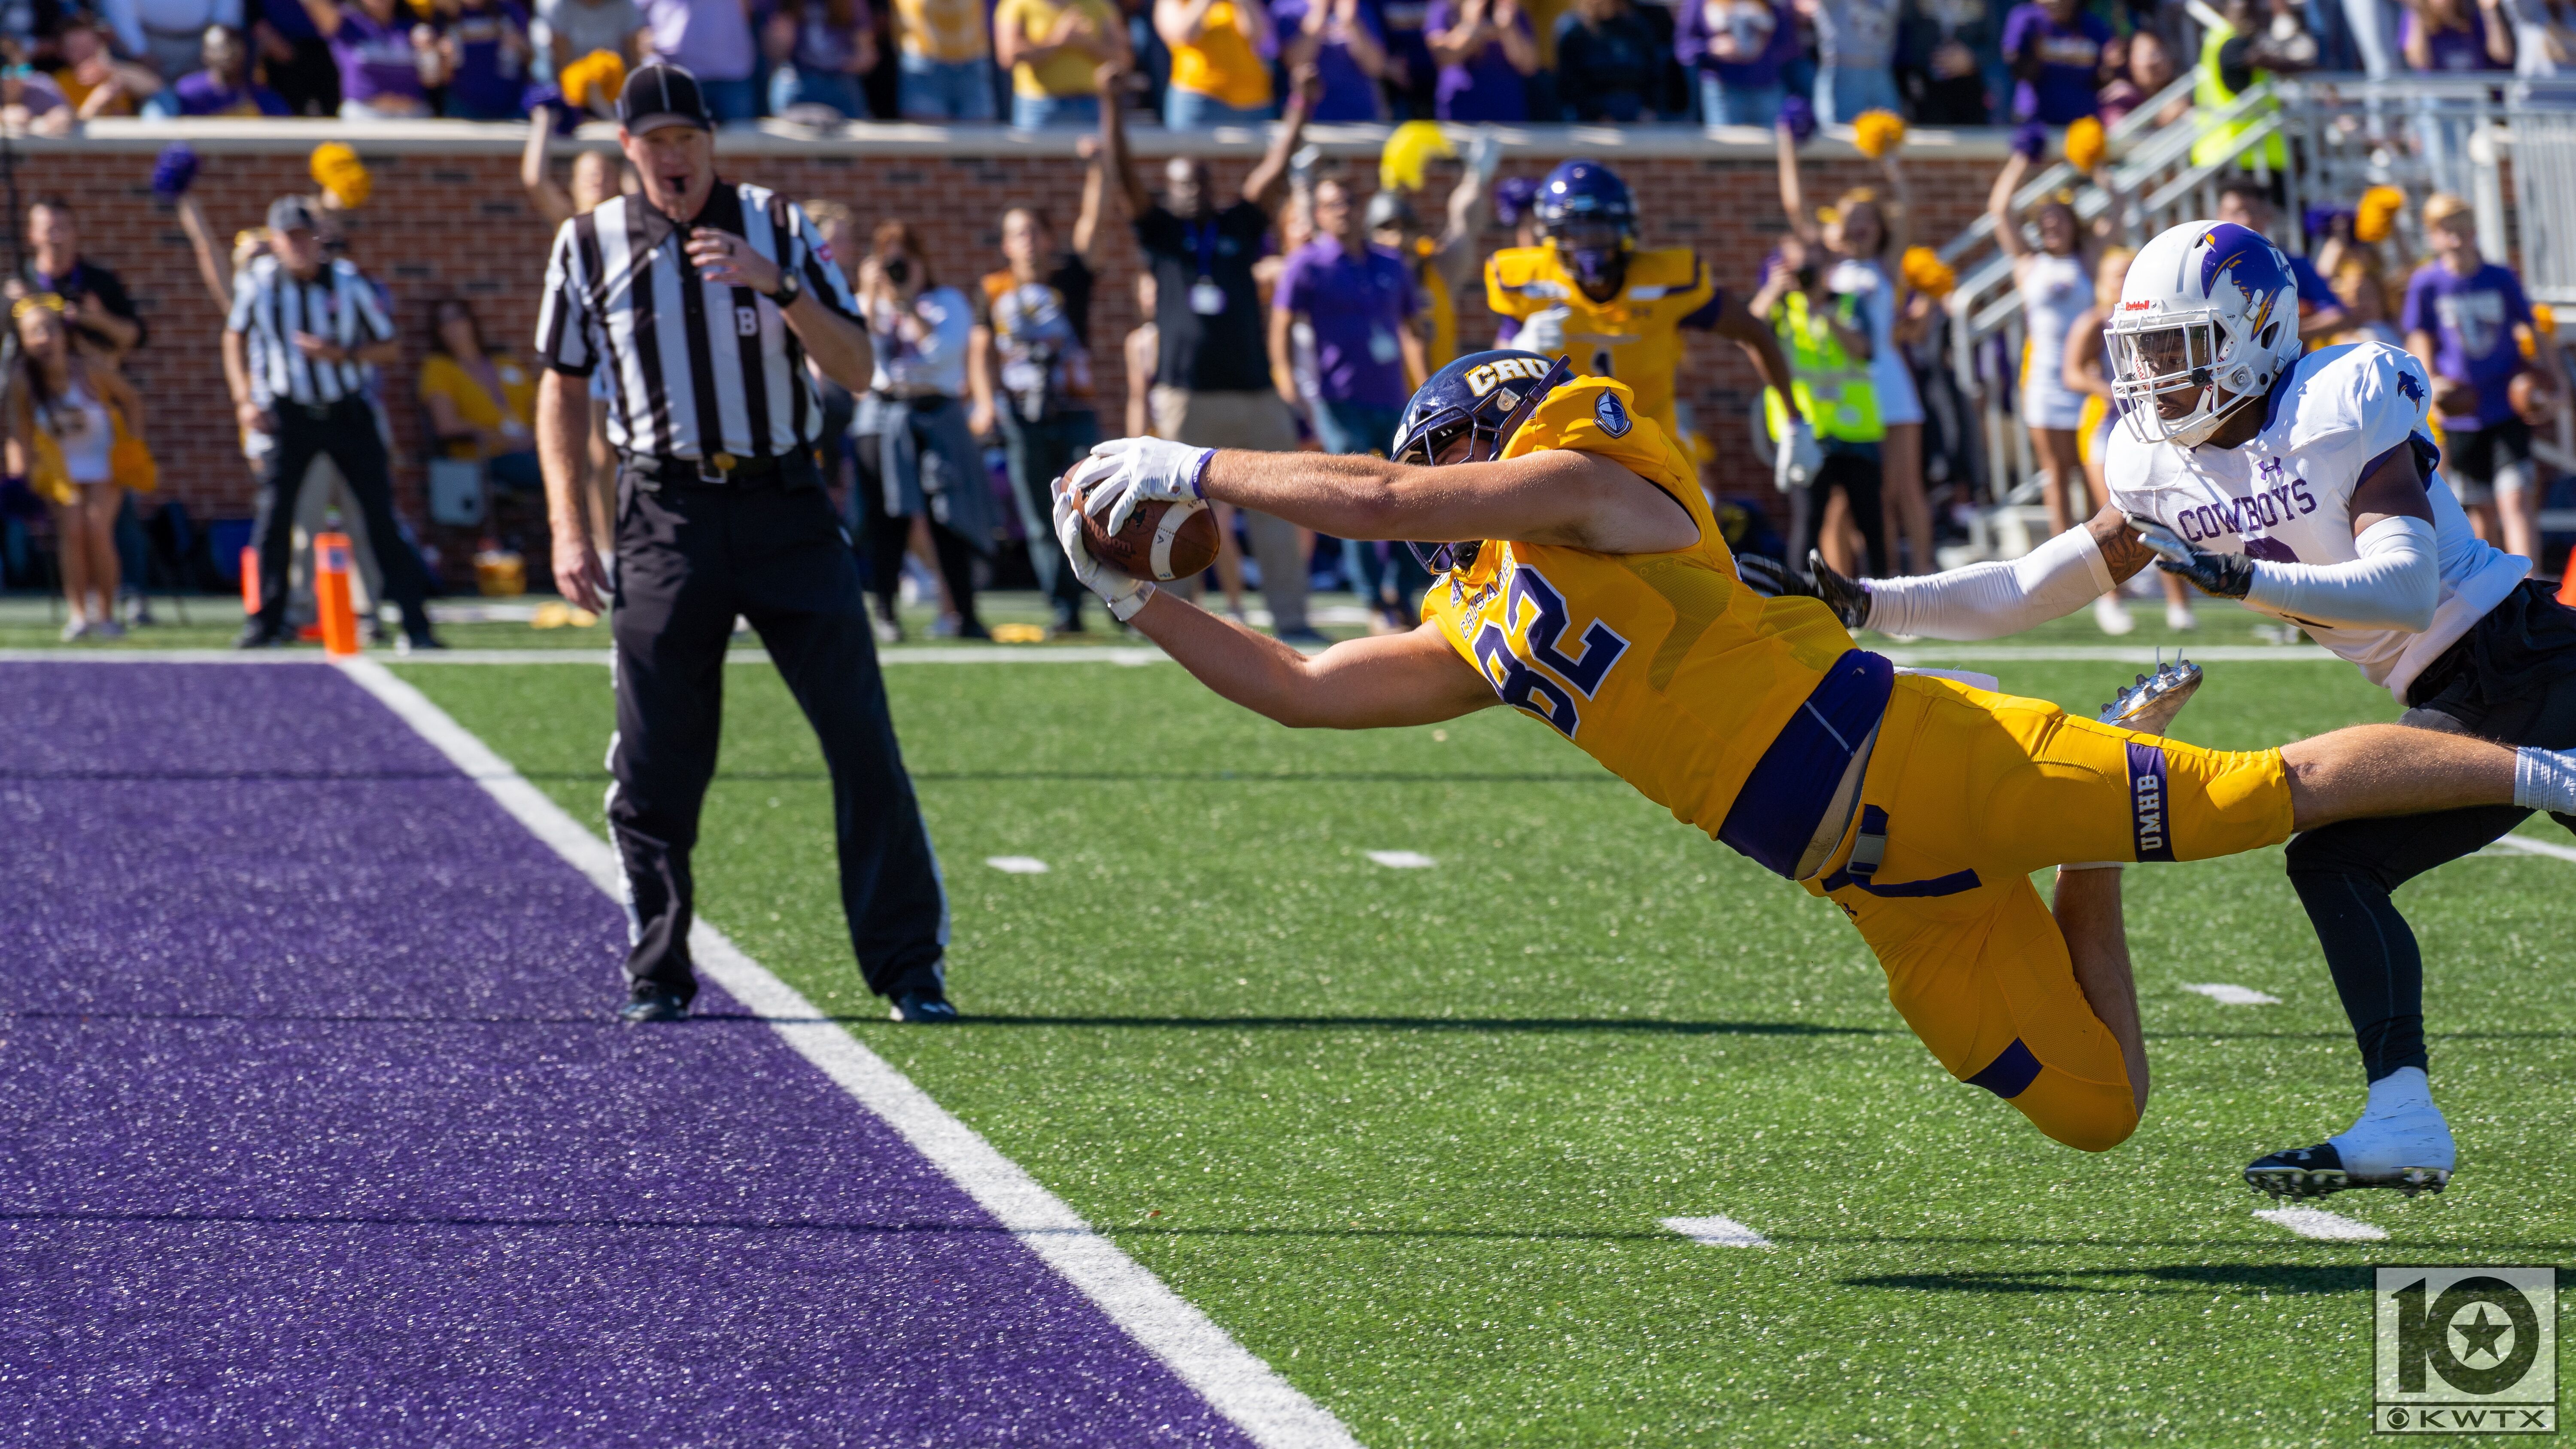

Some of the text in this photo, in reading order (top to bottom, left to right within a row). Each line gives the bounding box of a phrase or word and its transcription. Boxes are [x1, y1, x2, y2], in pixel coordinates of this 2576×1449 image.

[735, 306, 758, 337] B
[2126, 300, 2149, 310] Riddell
[1464, 365, 1482, 380] THE
[1467, 358, 1552, 397] CRU
[2177, 478, 2317, 543] COWBOYS
[1472, 563, 1631, 741] 82
[2137, 775, 2163, 851] UMHB
